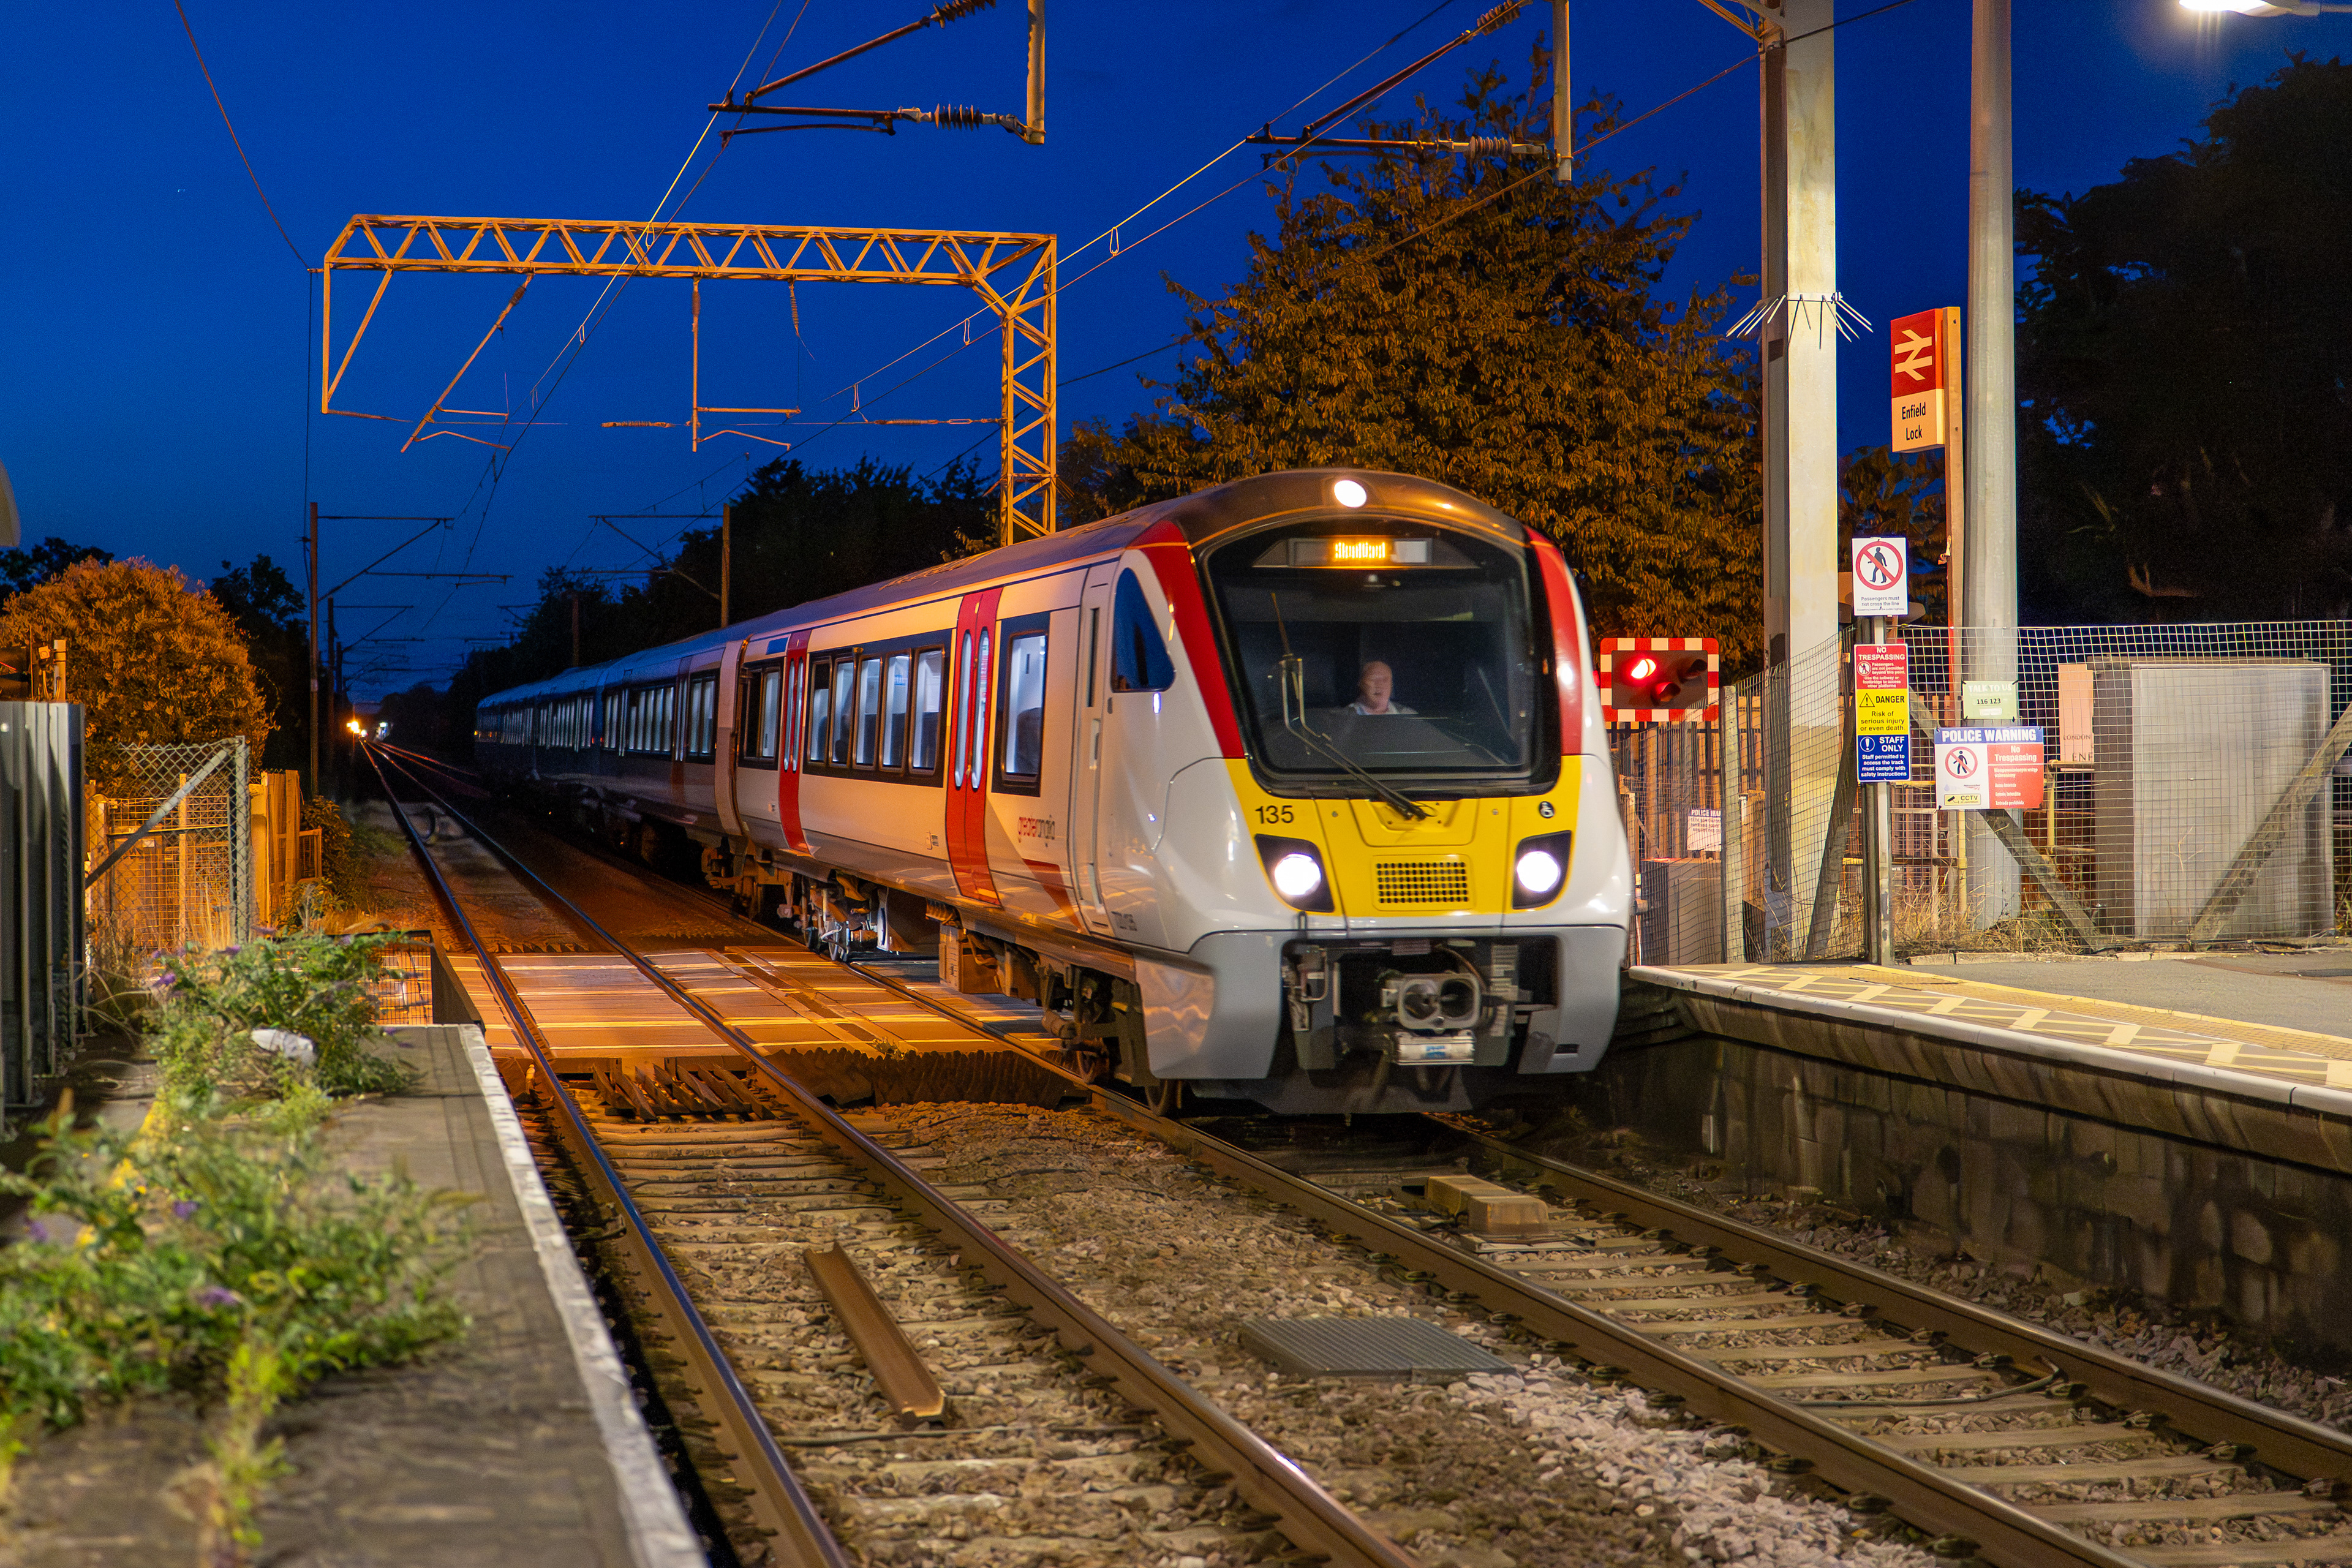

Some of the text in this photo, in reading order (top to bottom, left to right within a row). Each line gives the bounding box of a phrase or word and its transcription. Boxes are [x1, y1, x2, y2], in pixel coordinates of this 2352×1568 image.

[1902, 401, 1926, 420] Enfield
[1905, 424, 1922, 440] Lock
[1942, 729, 2037, 742] POLICE WARNING
[1994, 753, 2037, 763] Trespassing
[1255, 805, 1294, 824] 135
